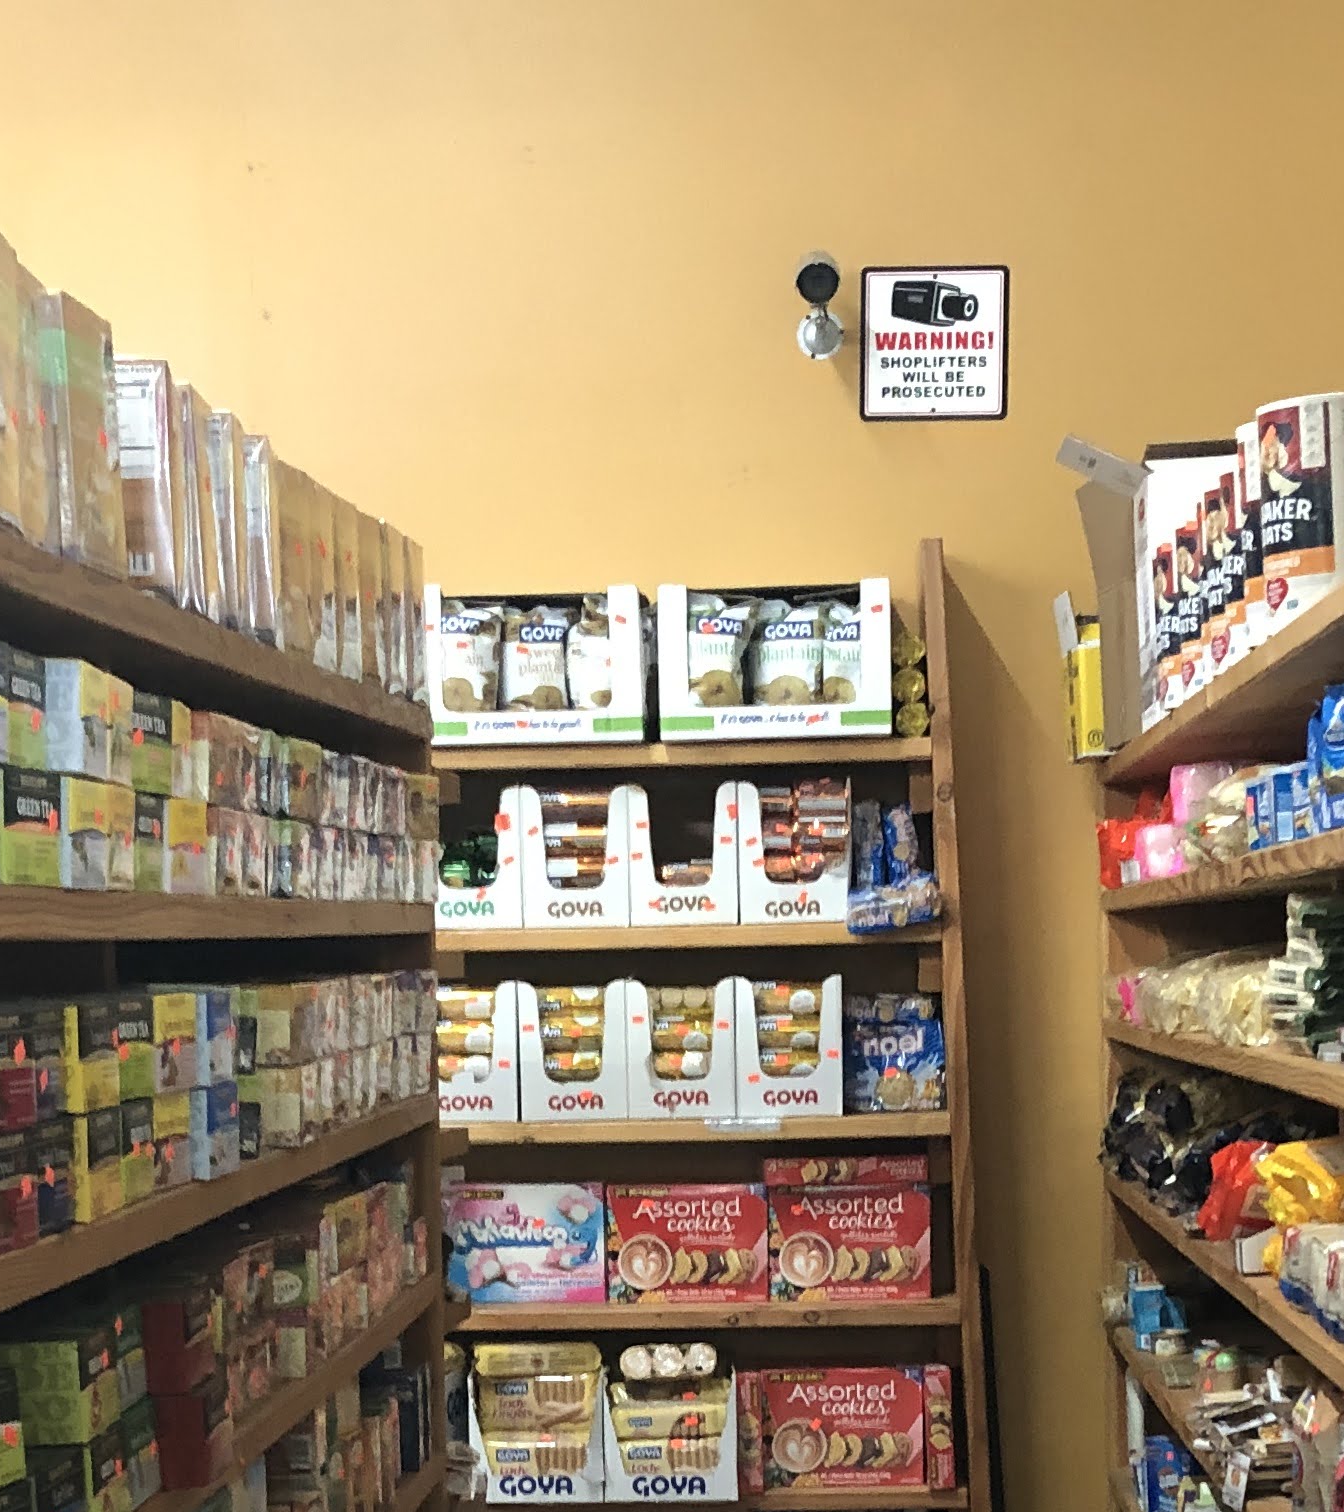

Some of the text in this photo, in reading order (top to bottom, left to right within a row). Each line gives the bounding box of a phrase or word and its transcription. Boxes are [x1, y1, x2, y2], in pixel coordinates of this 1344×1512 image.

[874, 331, 994, 351] WARNING!
[880, 356, 987, 369] SHOPLIFTERS
[902, 371, 965, 383] WILL BE
[881, 385, 986, 398] PROSECUTED
[1261, 498, 1312, 523] AKER
[1262, 522, 1293, 547] ATS
[764, 624, 812, 640] GOYA
[440, 901, 495, 918] GOYA
[548, 901, 604, 918] GOYA
[656, 896, 711, 914] GOYA
[765, 899, 821, 918] GOYA
[863, 1025, 924, 1057] noel
[439, 1094, 493, 1113] GOYA
[548, 1093, 604, 1112] GOYA
[653, 1090, 709, 1107] GOYA
[763, 1089, 818, 1106] GOYA
[632, 1195, 740, 1220] Assorted
[798, 1193, 905, 1217] Assorted
[667, 1213, 735, 1234] cookies
[828, 1210, 896, 1230] cookies
[787, 1382, 896, 1406] Assorted
[822, 1400, 888, 1418] cookies
[499, 1476, 573, 1498] GOYA
[632, 1476, 706, 1498] GOYA
